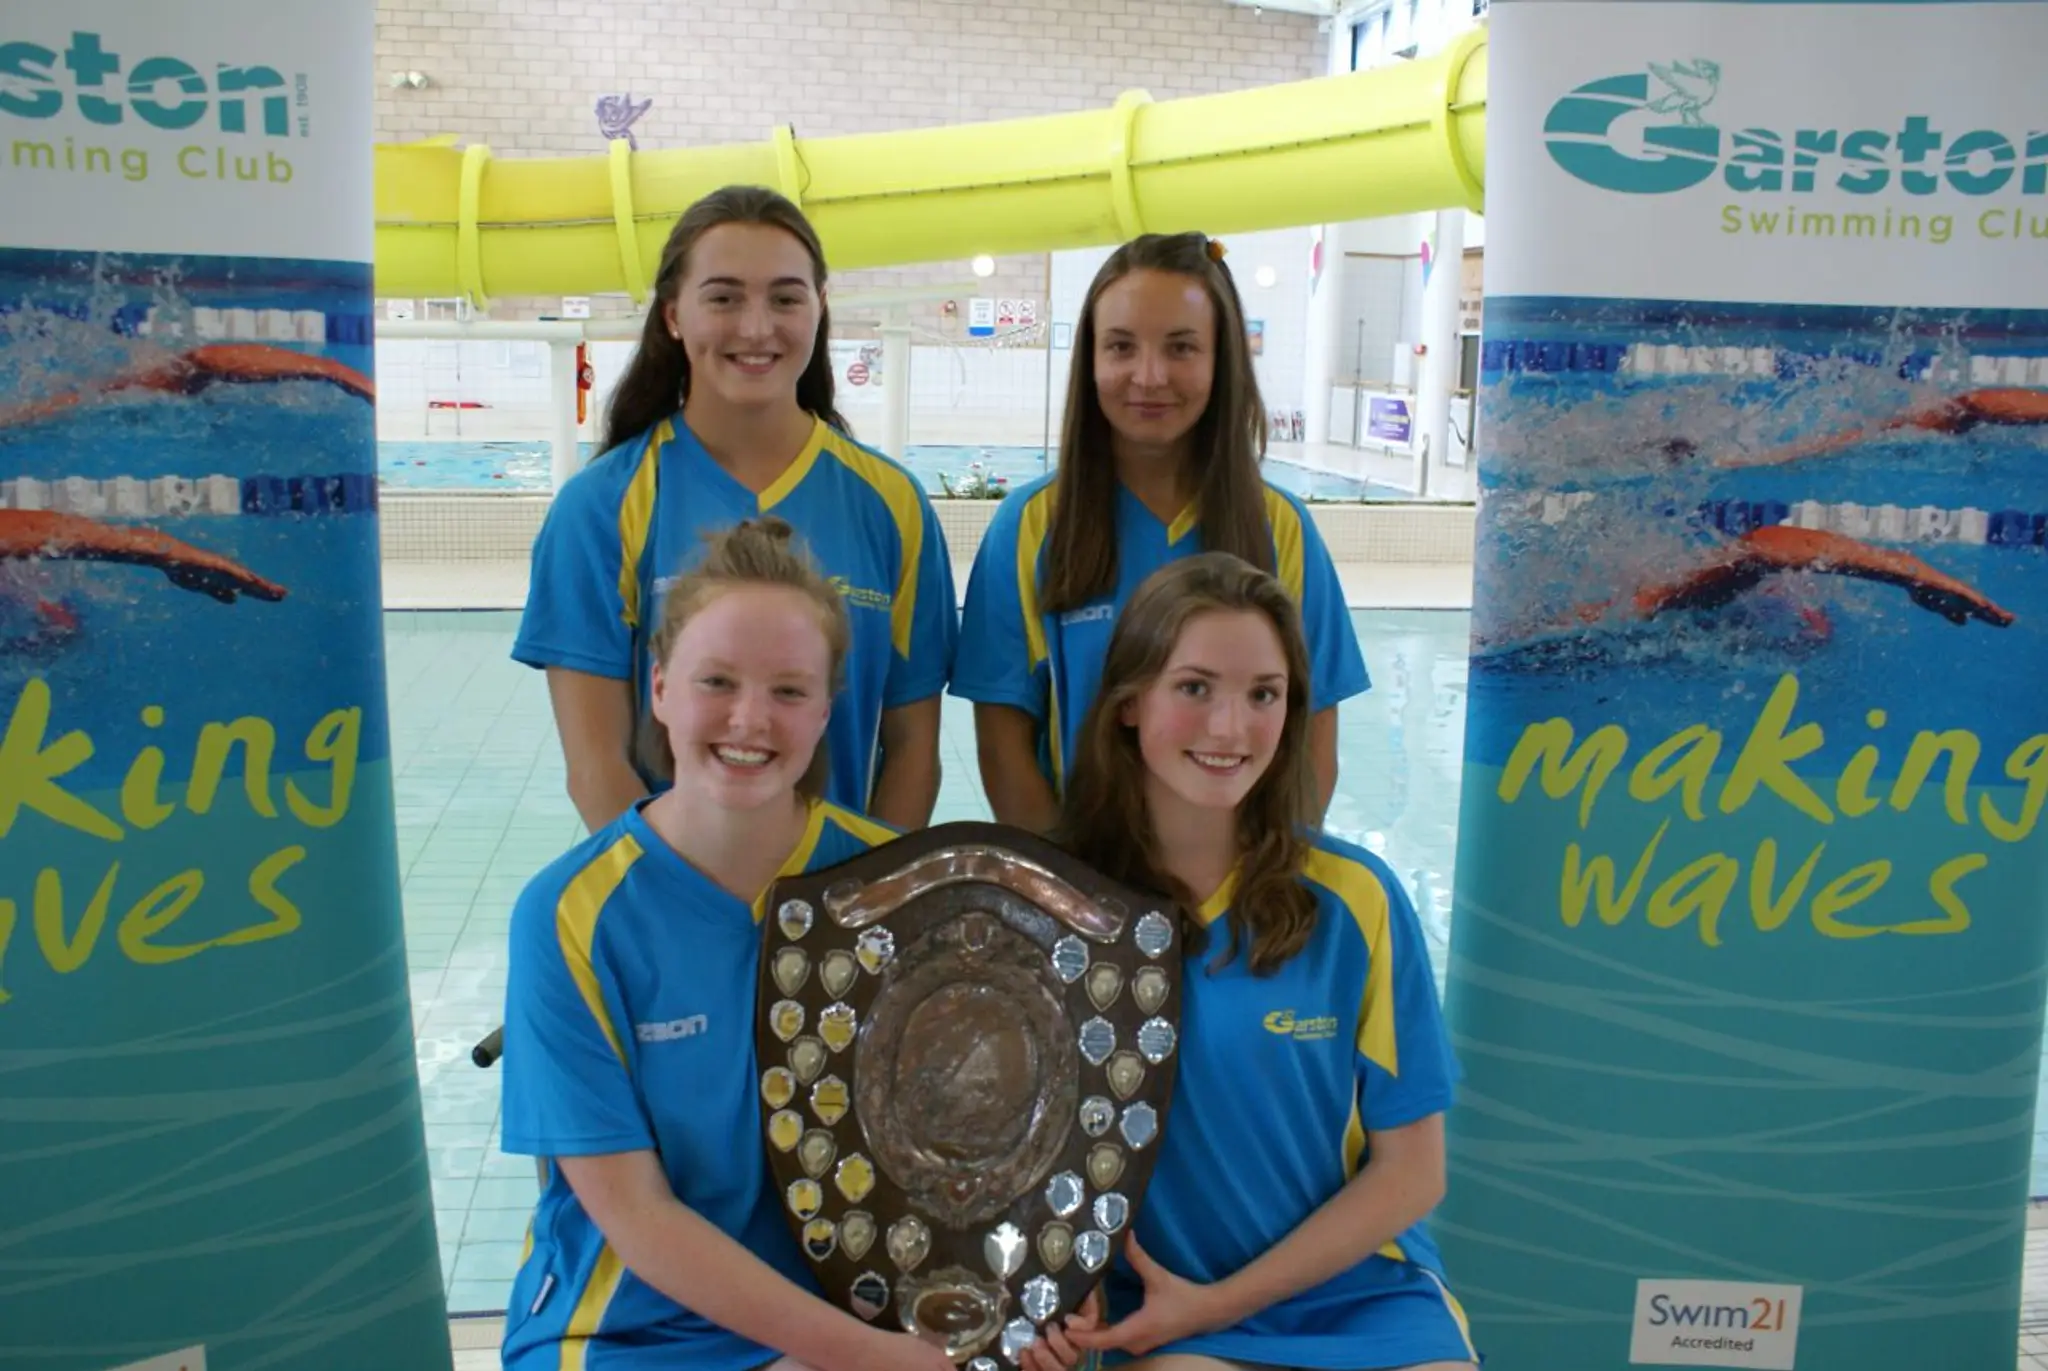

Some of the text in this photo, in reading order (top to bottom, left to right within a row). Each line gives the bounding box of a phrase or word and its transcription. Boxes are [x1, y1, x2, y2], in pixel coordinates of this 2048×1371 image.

[0, 31, 290, 137] ston
[0, 136, 294, 184] ming Club
[1720, 204, 1954, 244] Swimming
[0, 677, 362, 841] king
[1497, 673, 2048, 842] making
[1560, 816, 1988, 947] waves
[1648, 1294, 1786, 1332] Swim21
[1670, 1335, 1755, 1352] Accredited
